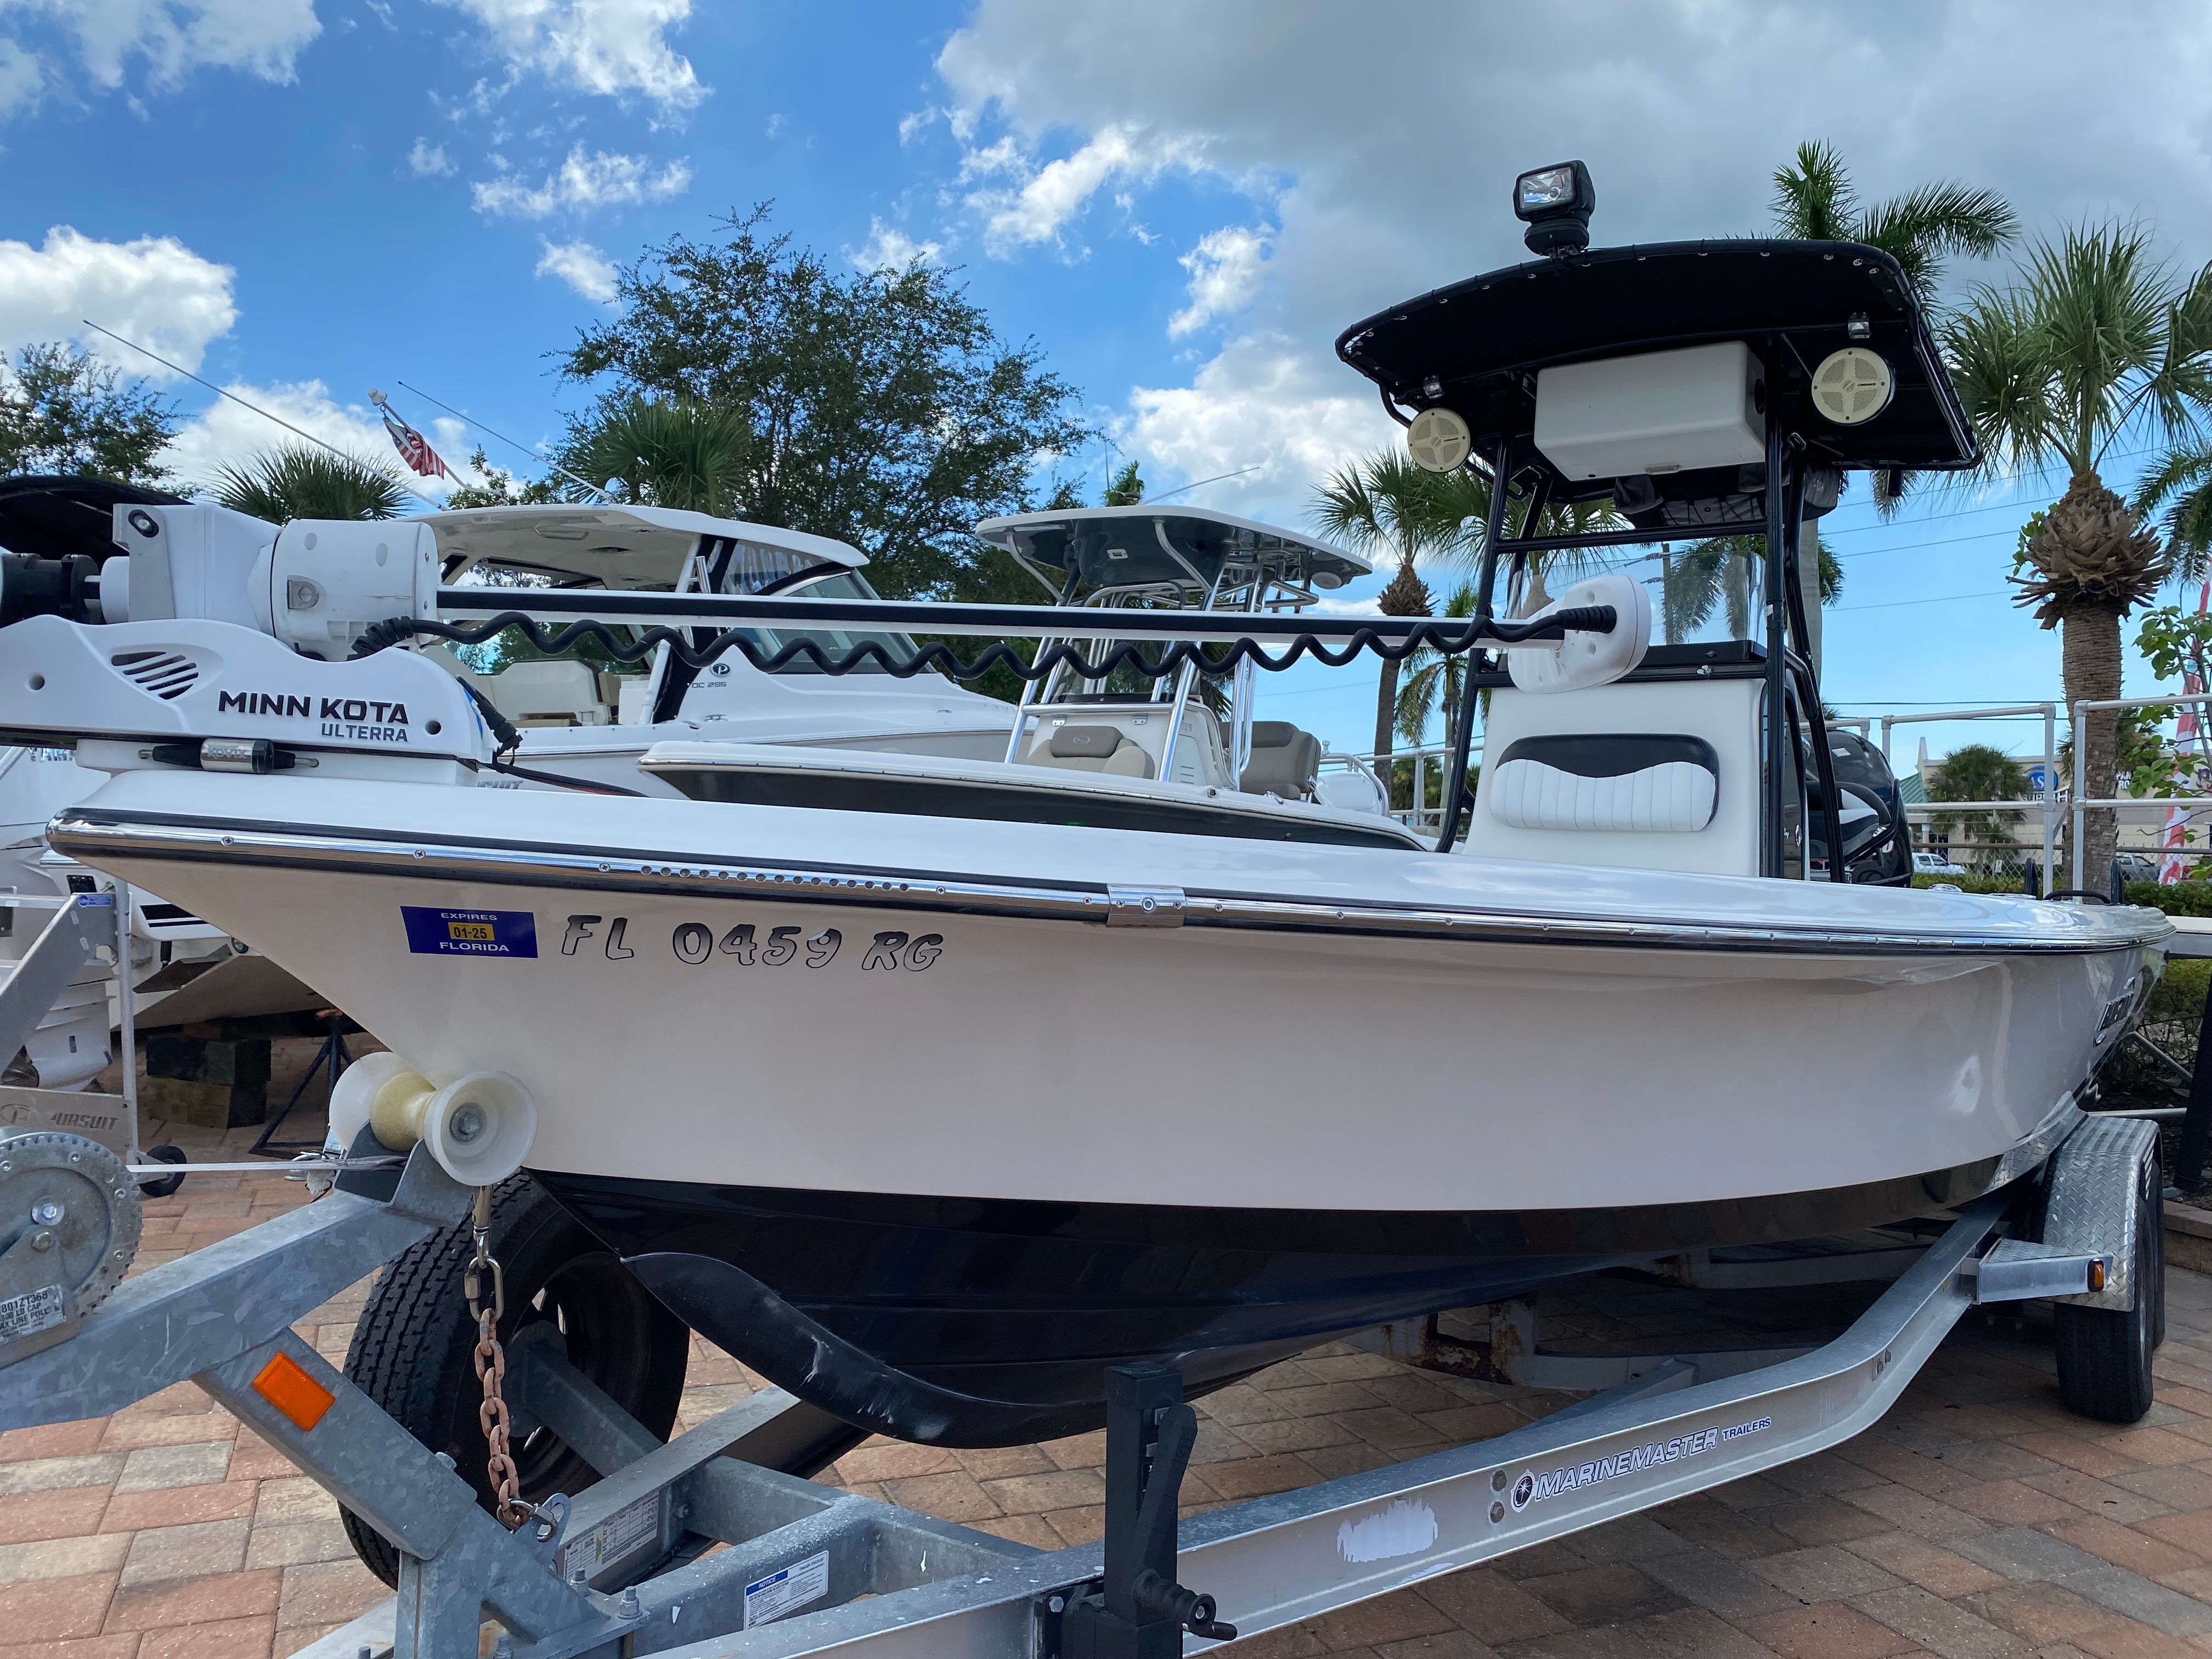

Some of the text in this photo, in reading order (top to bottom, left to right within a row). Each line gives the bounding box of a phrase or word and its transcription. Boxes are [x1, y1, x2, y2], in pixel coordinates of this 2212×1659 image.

[218, 690, 409, 725] MINN KOTA
[321, 723, 408, 742] ULTERRA
[441, 912, 498, 921] EXPIRES
[453, 927, 487, 939] 01-25
[440, 942, 509, 952] FLORIDA
[561, 915, 944, 972] FL 0459 RG
[50, 1112, 119, 1130] URSUIT
[1536, 1418, 1772, 1501] MARINEMASTER TRAILERS
[758, 1576, 777, 1589] NOTICE
